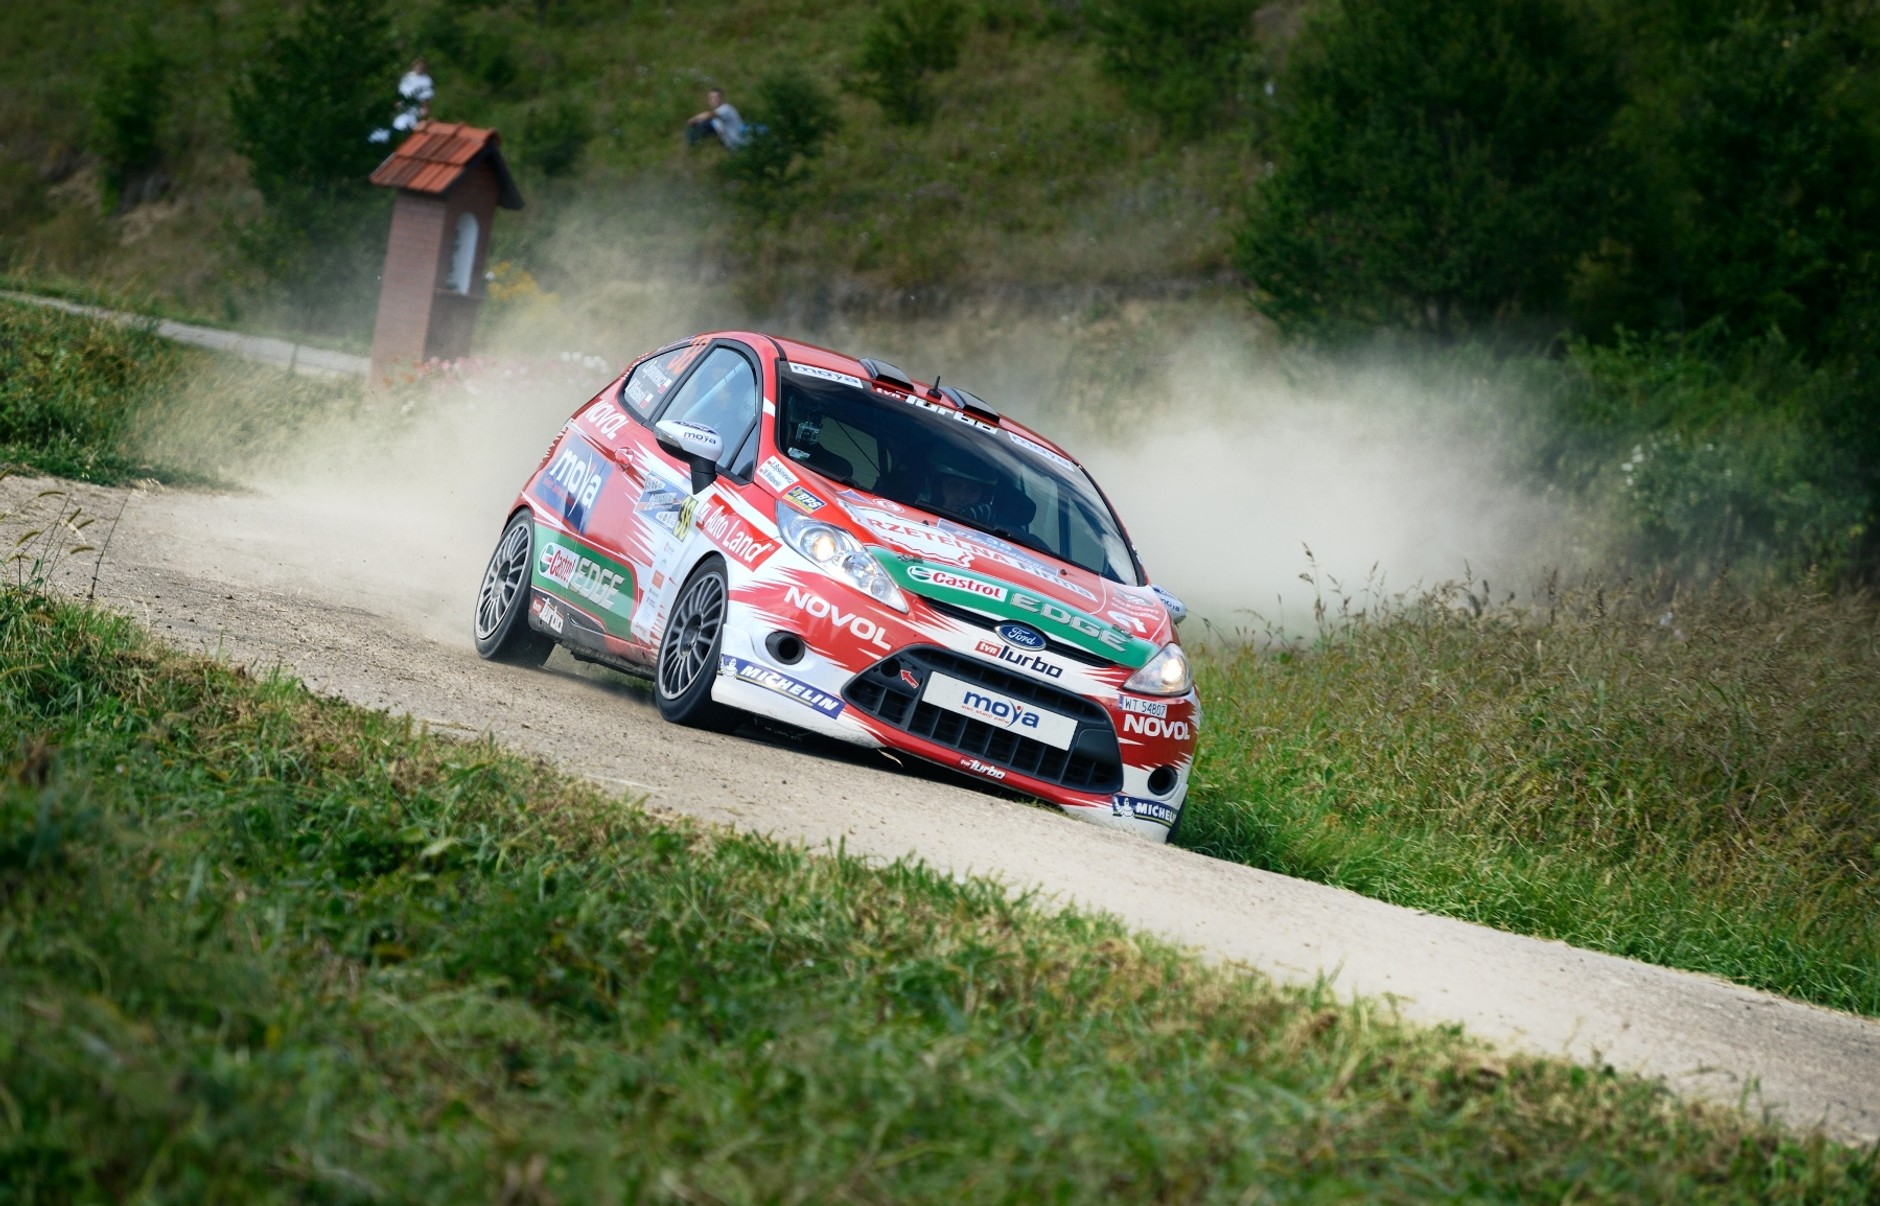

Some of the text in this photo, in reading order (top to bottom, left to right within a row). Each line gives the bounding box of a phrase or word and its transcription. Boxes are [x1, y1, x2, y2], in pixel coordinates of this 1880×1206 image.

[793, 365, 859, 384] moya
[896, 390, 998, 434] Turbo
[683, 431, 717, 445] moya
[549, 448, 603, 518] moya
[672, 495, 698, 541] 38
[703, 504, 728, 541] Auto
[866, 518, 1010, 564] RZETELNA
[1017, 560, 1093, 598] Firma
[549, 549, 577, 582] Castrol
[571, 557, 626, 610] EDGE
[539, 597, 565, 634] Turbo
[784, 586, 892, 651] NOVOL
[932, 572, 1001, 599] Castrol
[1011, 592, 1130, 653] EDGE
[1006, 626, 1037, 646] Ford
[978, 641, 1064, 679] tvn Turbo
[740, 664, 840, 712] MICHELIN
[963, 690, 1040, 728] moya
[1123, 713, 1191, 740] NOVOL
[1125, 698, 1166, 717] WT 54807
[969, 758, 1007, 780] Turbo
